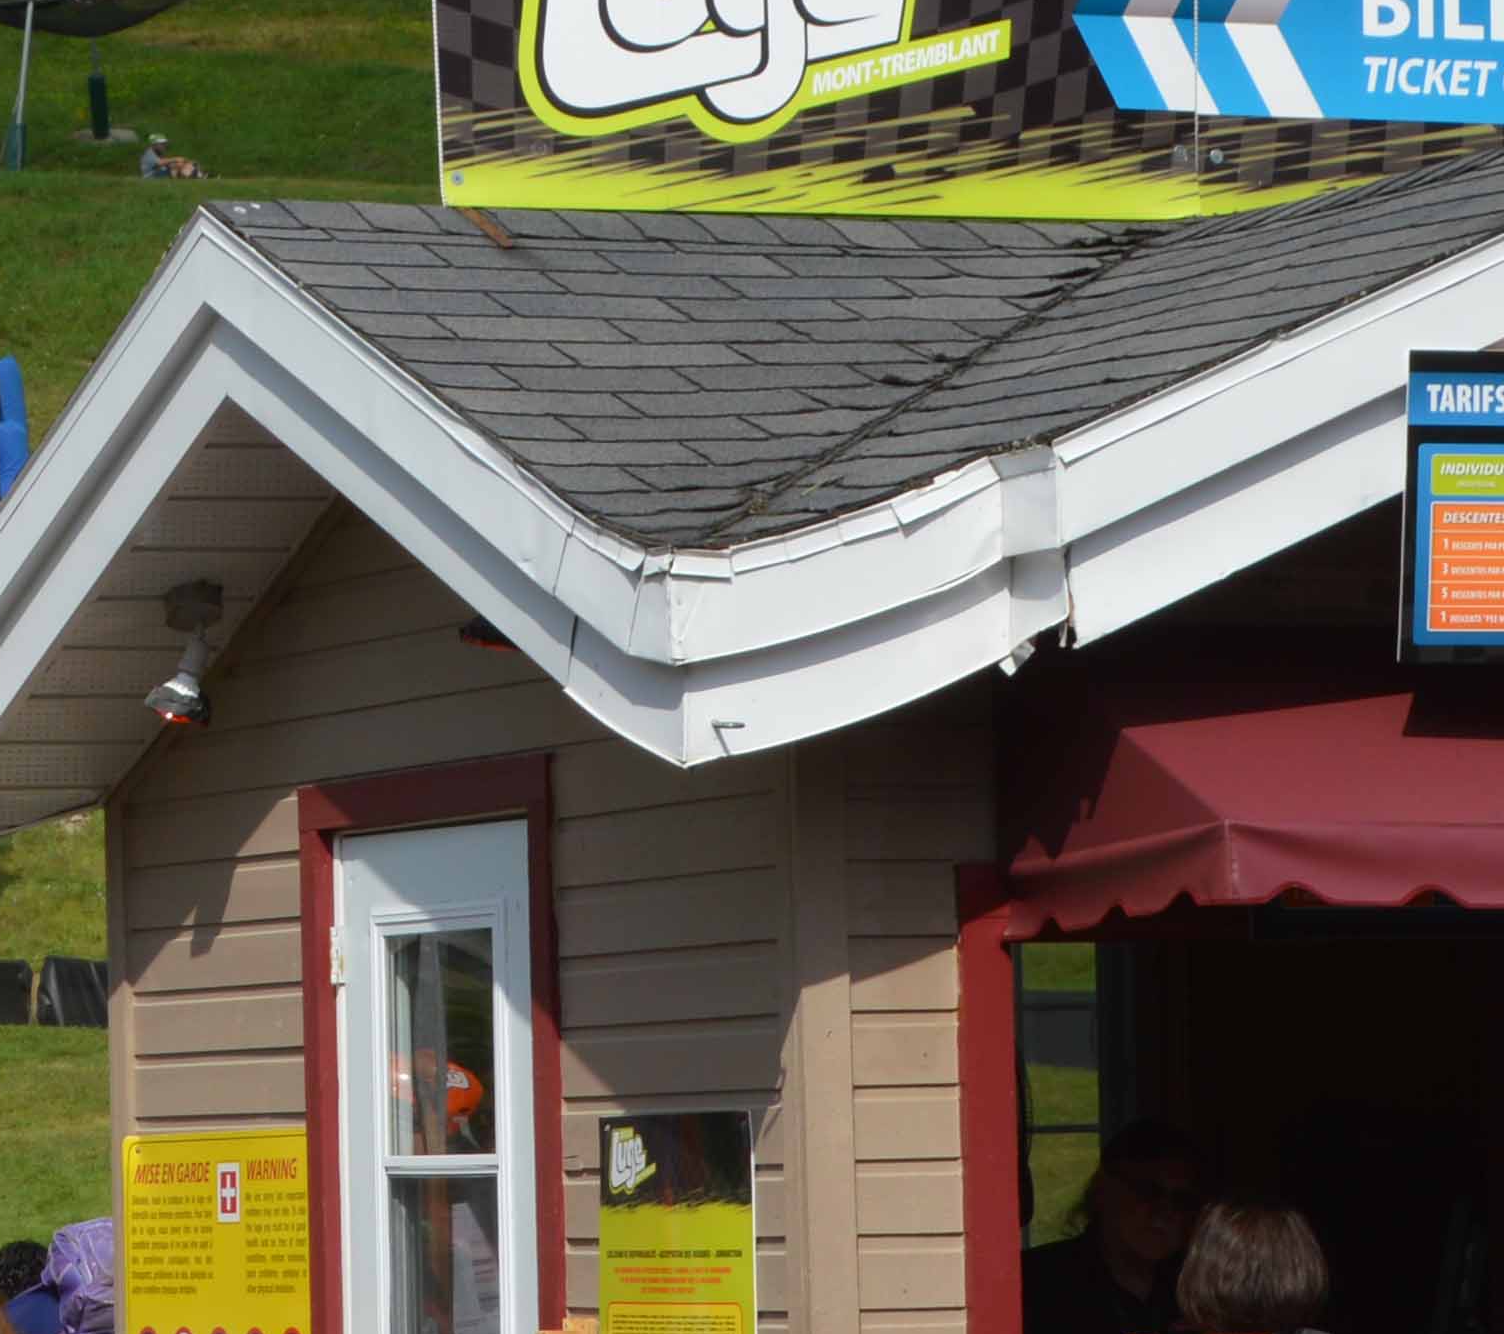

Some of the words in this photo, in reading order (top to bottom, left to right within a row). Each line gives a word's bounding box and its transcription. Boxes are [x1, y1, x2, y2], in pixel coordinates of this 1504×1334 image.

[812, 28, 1002, 97] MONT-TREMBLANT
[1363, 56, 1496, 98] TICKET
[135, 1163, 160, 1184] MISE
[161, 1163, 173, 1184] EN
[176, 1161, 210, 1183] GARDE
[246, 1158, 298, 1180] WARNING
[610, 1130, 647, 1189] Luge
